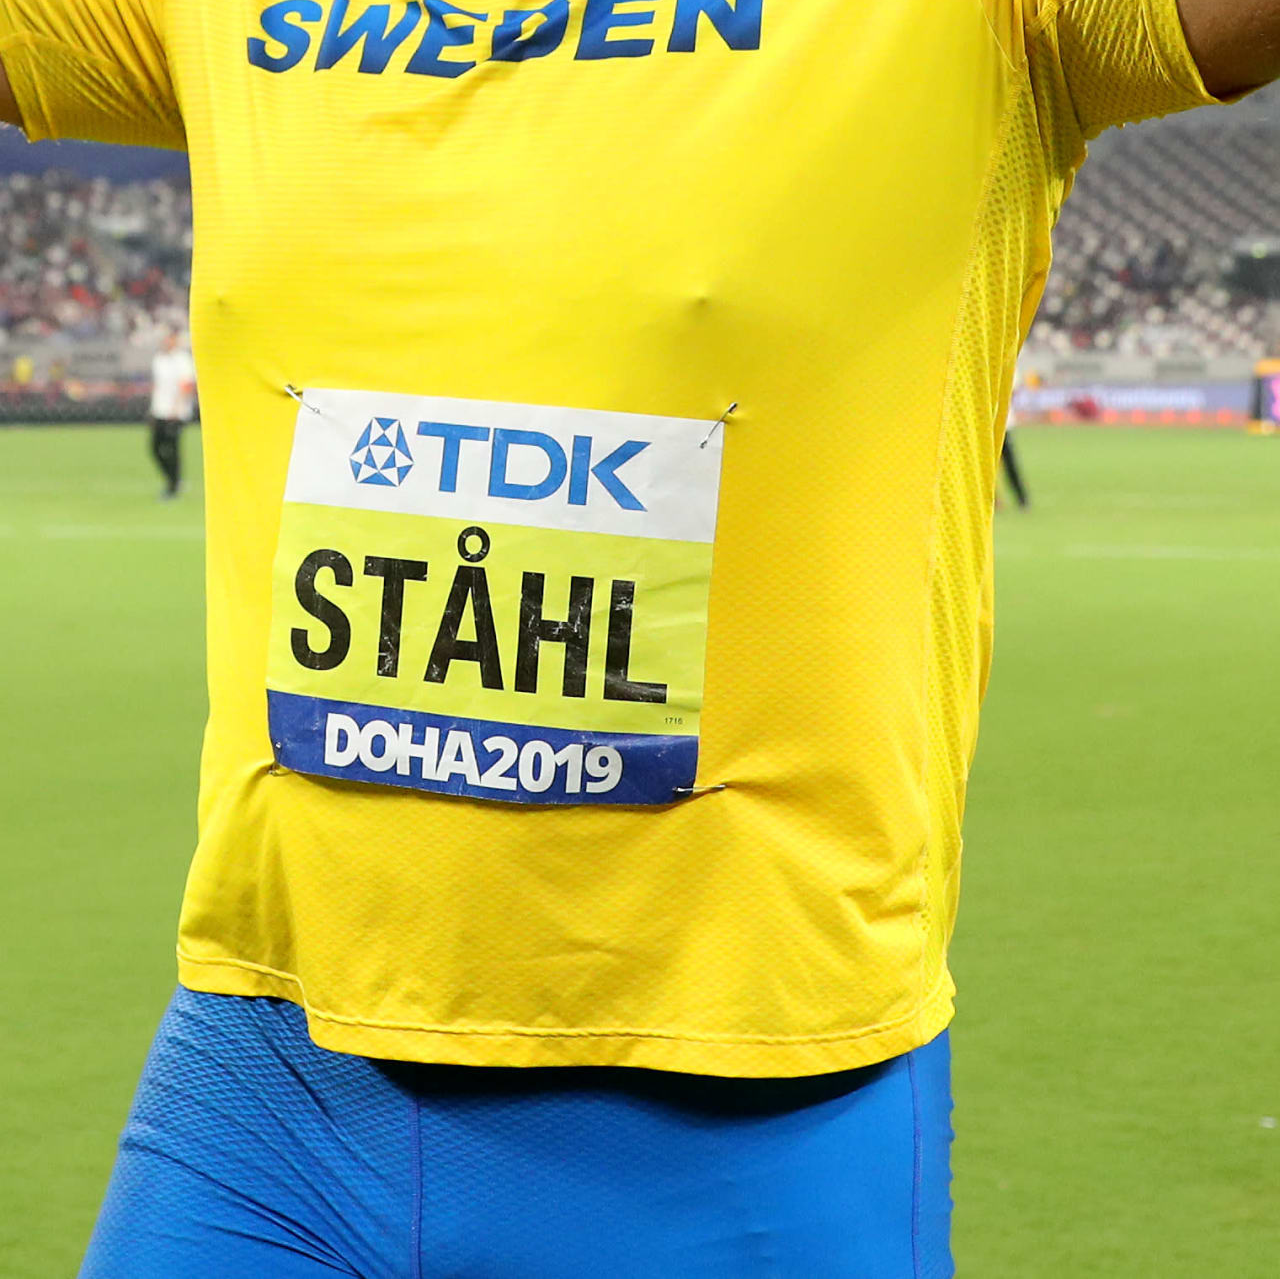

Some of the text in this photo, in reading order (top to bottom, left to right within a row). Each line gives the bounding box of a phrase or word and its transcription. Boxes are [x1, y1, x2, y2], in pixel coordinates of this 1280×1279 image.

[416, 420, 653, 512] TDK
[290, 526, 668, 704] STÅHL
[324, 713, 622, 794] DOHA2019
